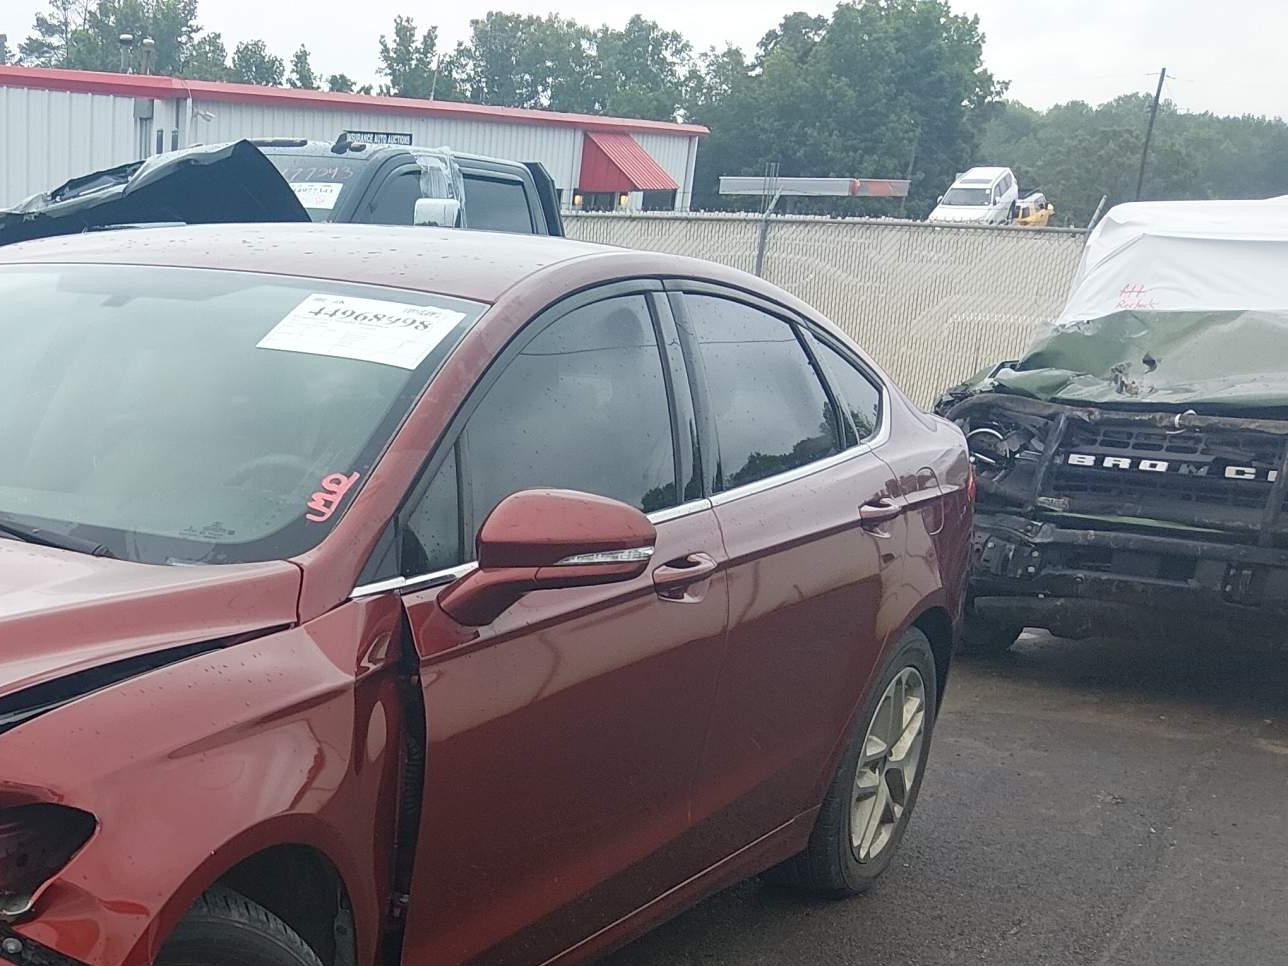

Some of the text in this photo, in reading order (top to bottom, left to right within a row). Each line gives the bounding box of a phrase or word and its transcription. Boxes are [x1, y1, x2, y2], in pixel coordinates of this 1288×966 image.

[374, 134, 387, 144] AUTO
[388, 135, 410, 145] AUCTIONS
[1067, 453, 1279, 482] BRONC
